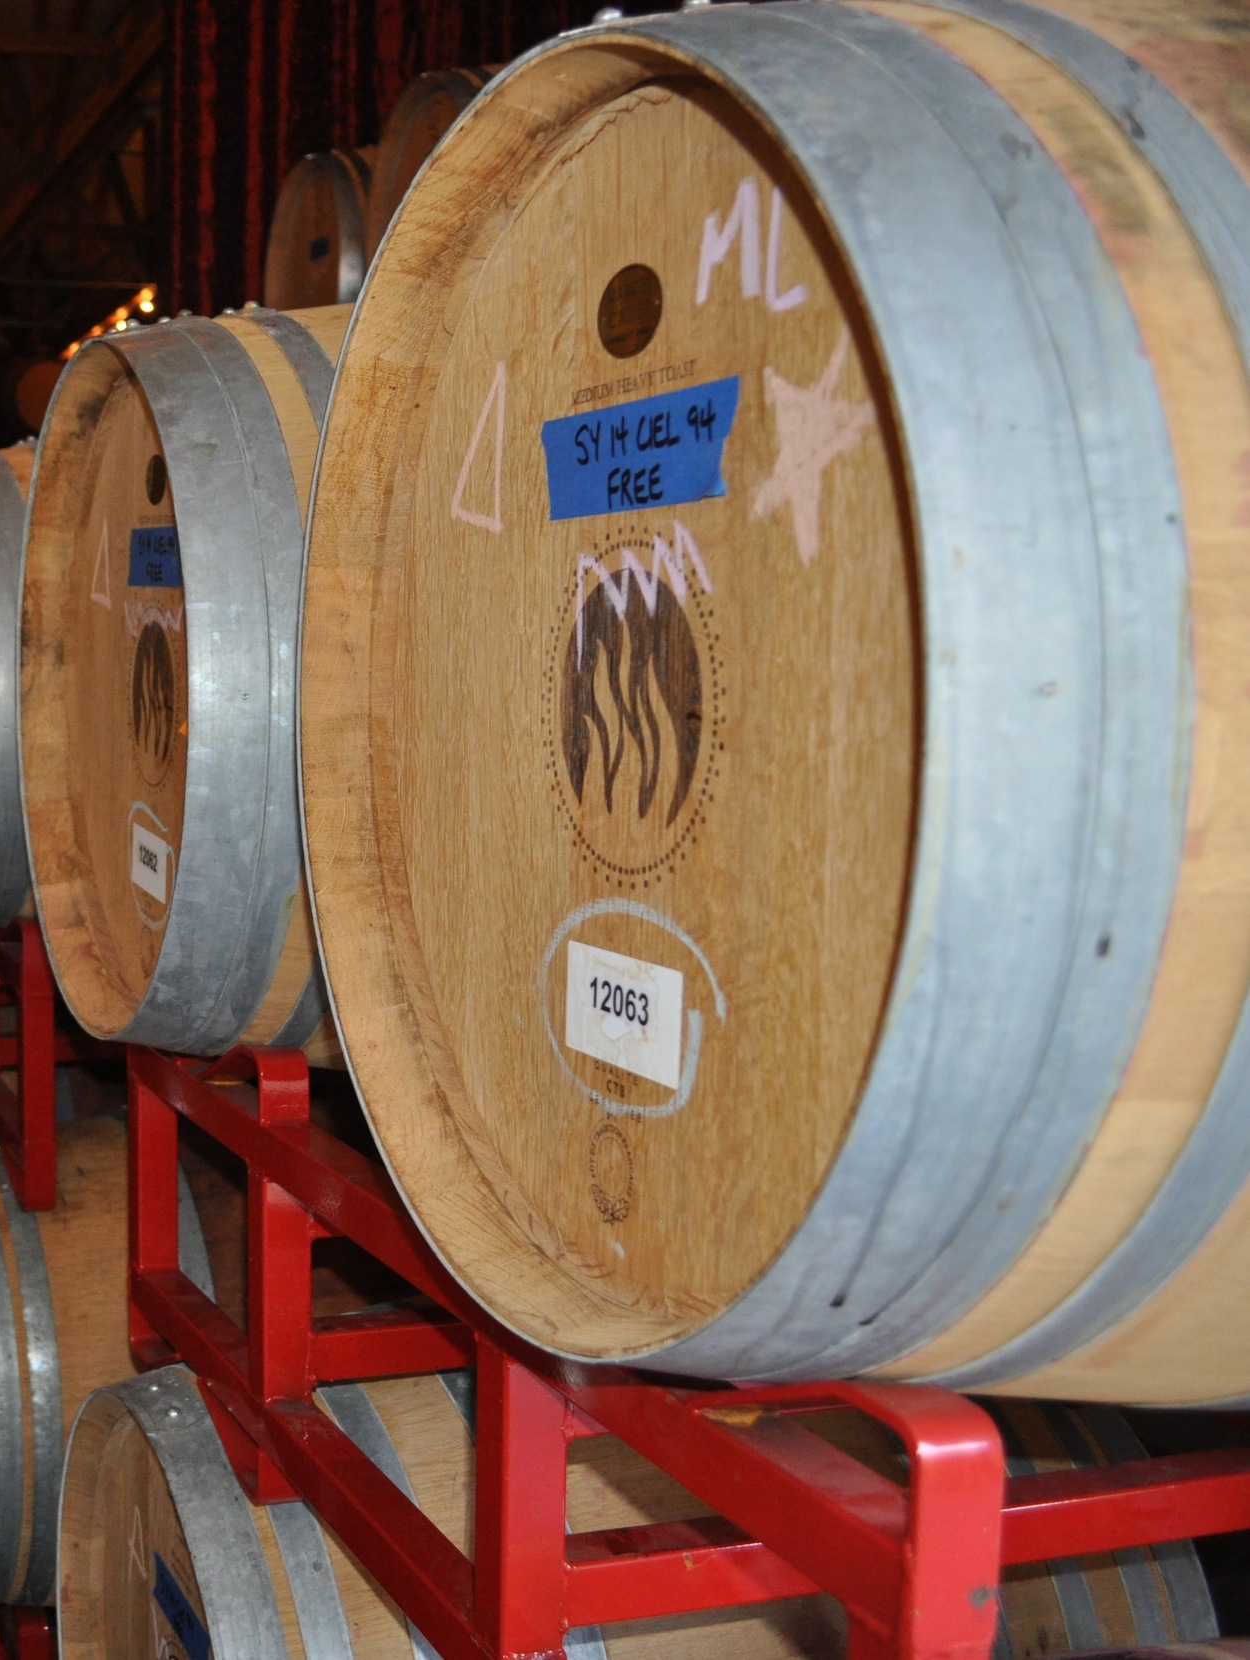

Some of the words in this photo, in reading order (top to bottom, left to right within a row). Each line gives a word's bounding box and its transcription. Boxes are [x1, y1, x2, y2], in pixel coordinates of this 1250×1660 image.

[570, 382, 614, 405] MEDIUM
[617, 373, 655, 394] HEAVY
[658, 359, 696, 384] TOAST
[611, 416, 628, 458] 14
[688, 398, 717, 443] 94
[607, 463, 664, 509] FREE
[590, 976, 649, 1026] 12063
